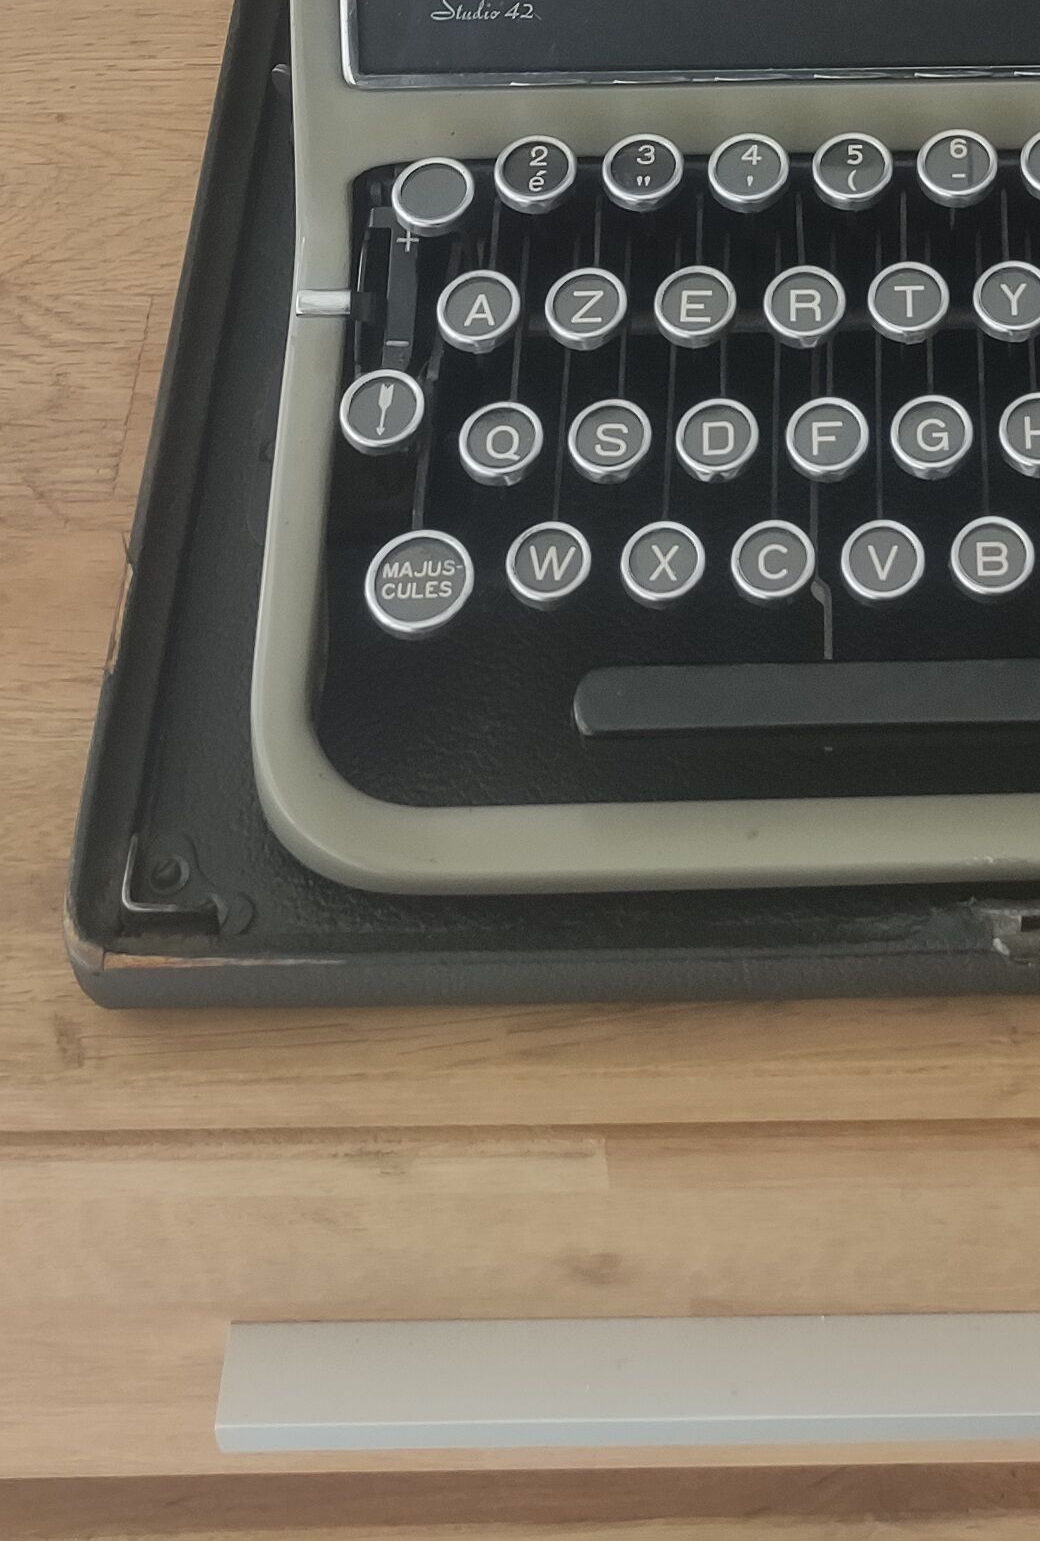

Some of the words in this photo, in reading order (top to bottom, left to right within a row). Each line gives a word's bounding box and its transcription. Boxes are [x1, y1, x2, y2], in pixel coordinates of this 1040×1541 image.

[505, 3, 533, 19] 42
[530, 146, 548, 166] 2
[637, 145, 655, 164] 3
[742, 145, 762, 165] 4
[847, 145, 862, 164] 5
[950, 139, 967, 158] 6
[529, 171, 546, 193] é
[464, 294, 494, 326] A
[571, 291, 606, 324] Z
[680, 291, 712, 322] E
[790, 290, 821, 321] R
[894, 286, 924, 317] T
[1001, 284, 1026, 315] Y
[486, 426, 521, 461] Q
[595, 424, 628, 456] S
[703, 421, 734, 455] D
[812, 422, 842, 455] F
[917, 419, 948, 451] G
[381, 559, 465, 580] MAJUS-
[530, 546, 577, 582] W
[650, 545, 679, 581] X
[759, 544, 788, 579] C
[868, 545, 898, 580] V
[977, 542, 1008, 576] B
[382, 578, 451, 599] CULES
